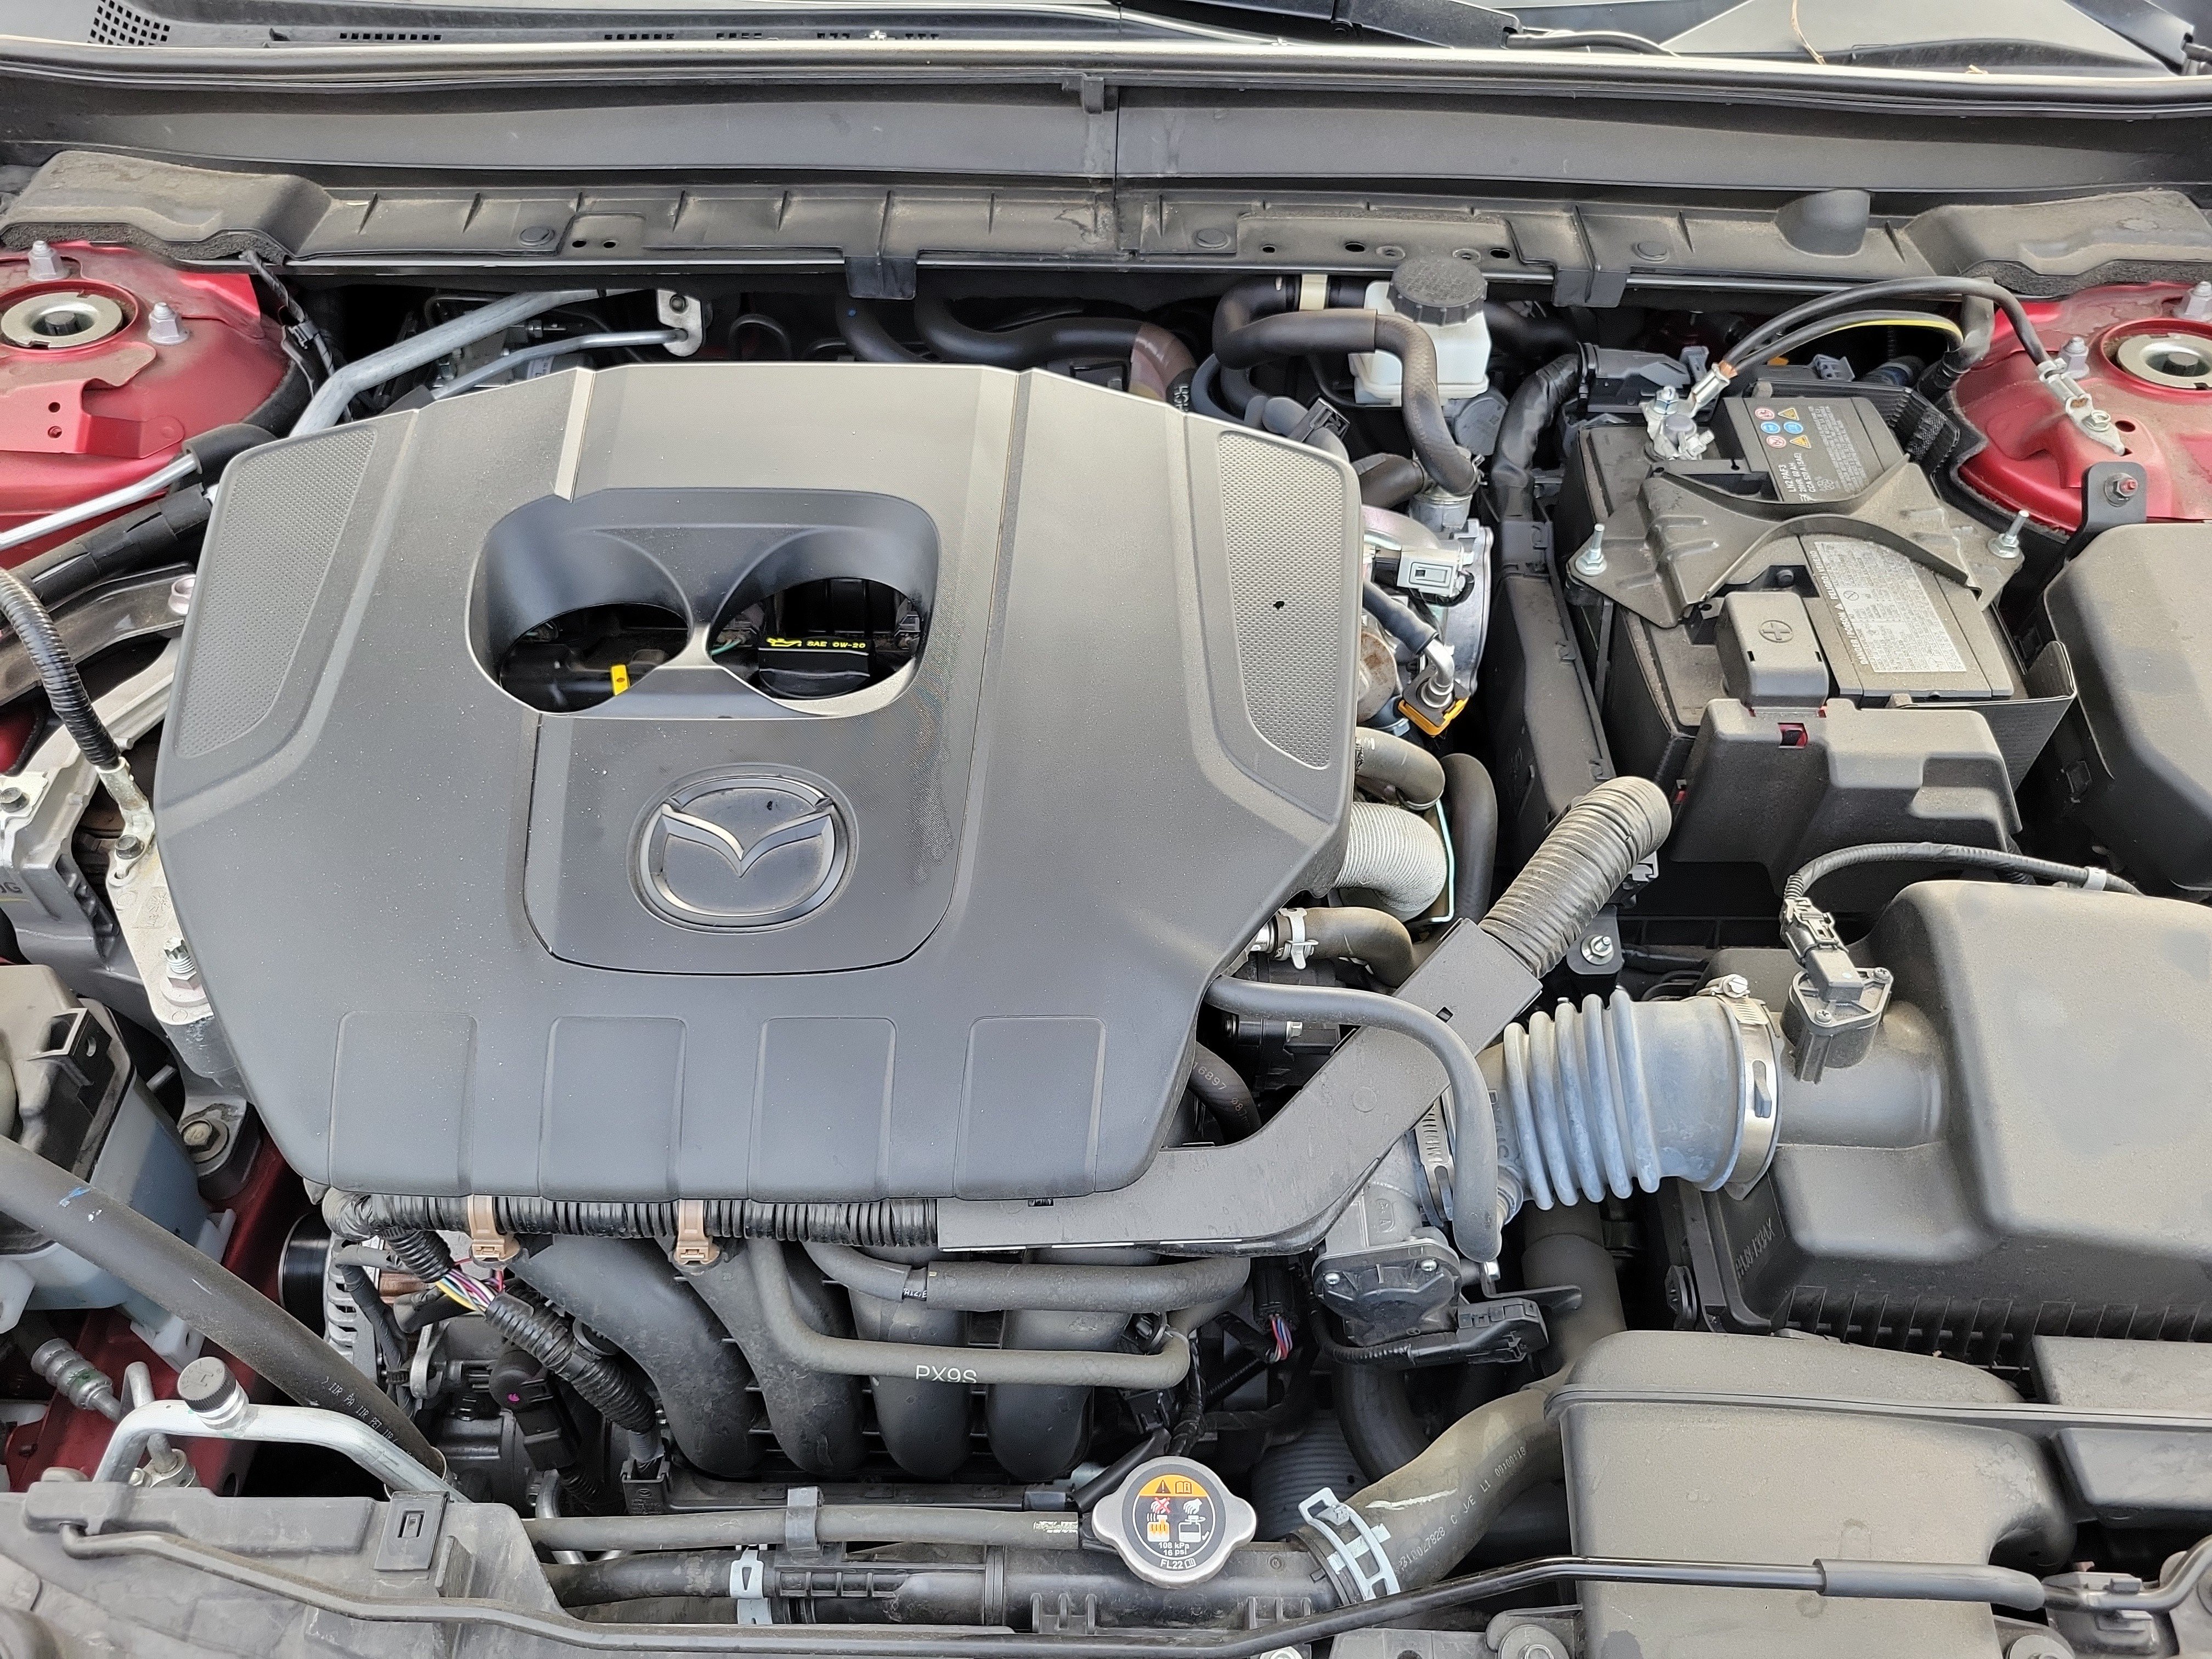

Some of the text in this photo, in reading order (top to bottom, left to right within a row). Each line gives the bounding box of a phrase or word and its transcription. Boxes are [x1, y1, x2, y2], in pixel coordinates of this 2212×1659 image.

[915, 1364, 977, 1384] PX9S
[1174, 1542, 1190, 1550] kPa
[1160, 1558, 1184, 1570] FL22
